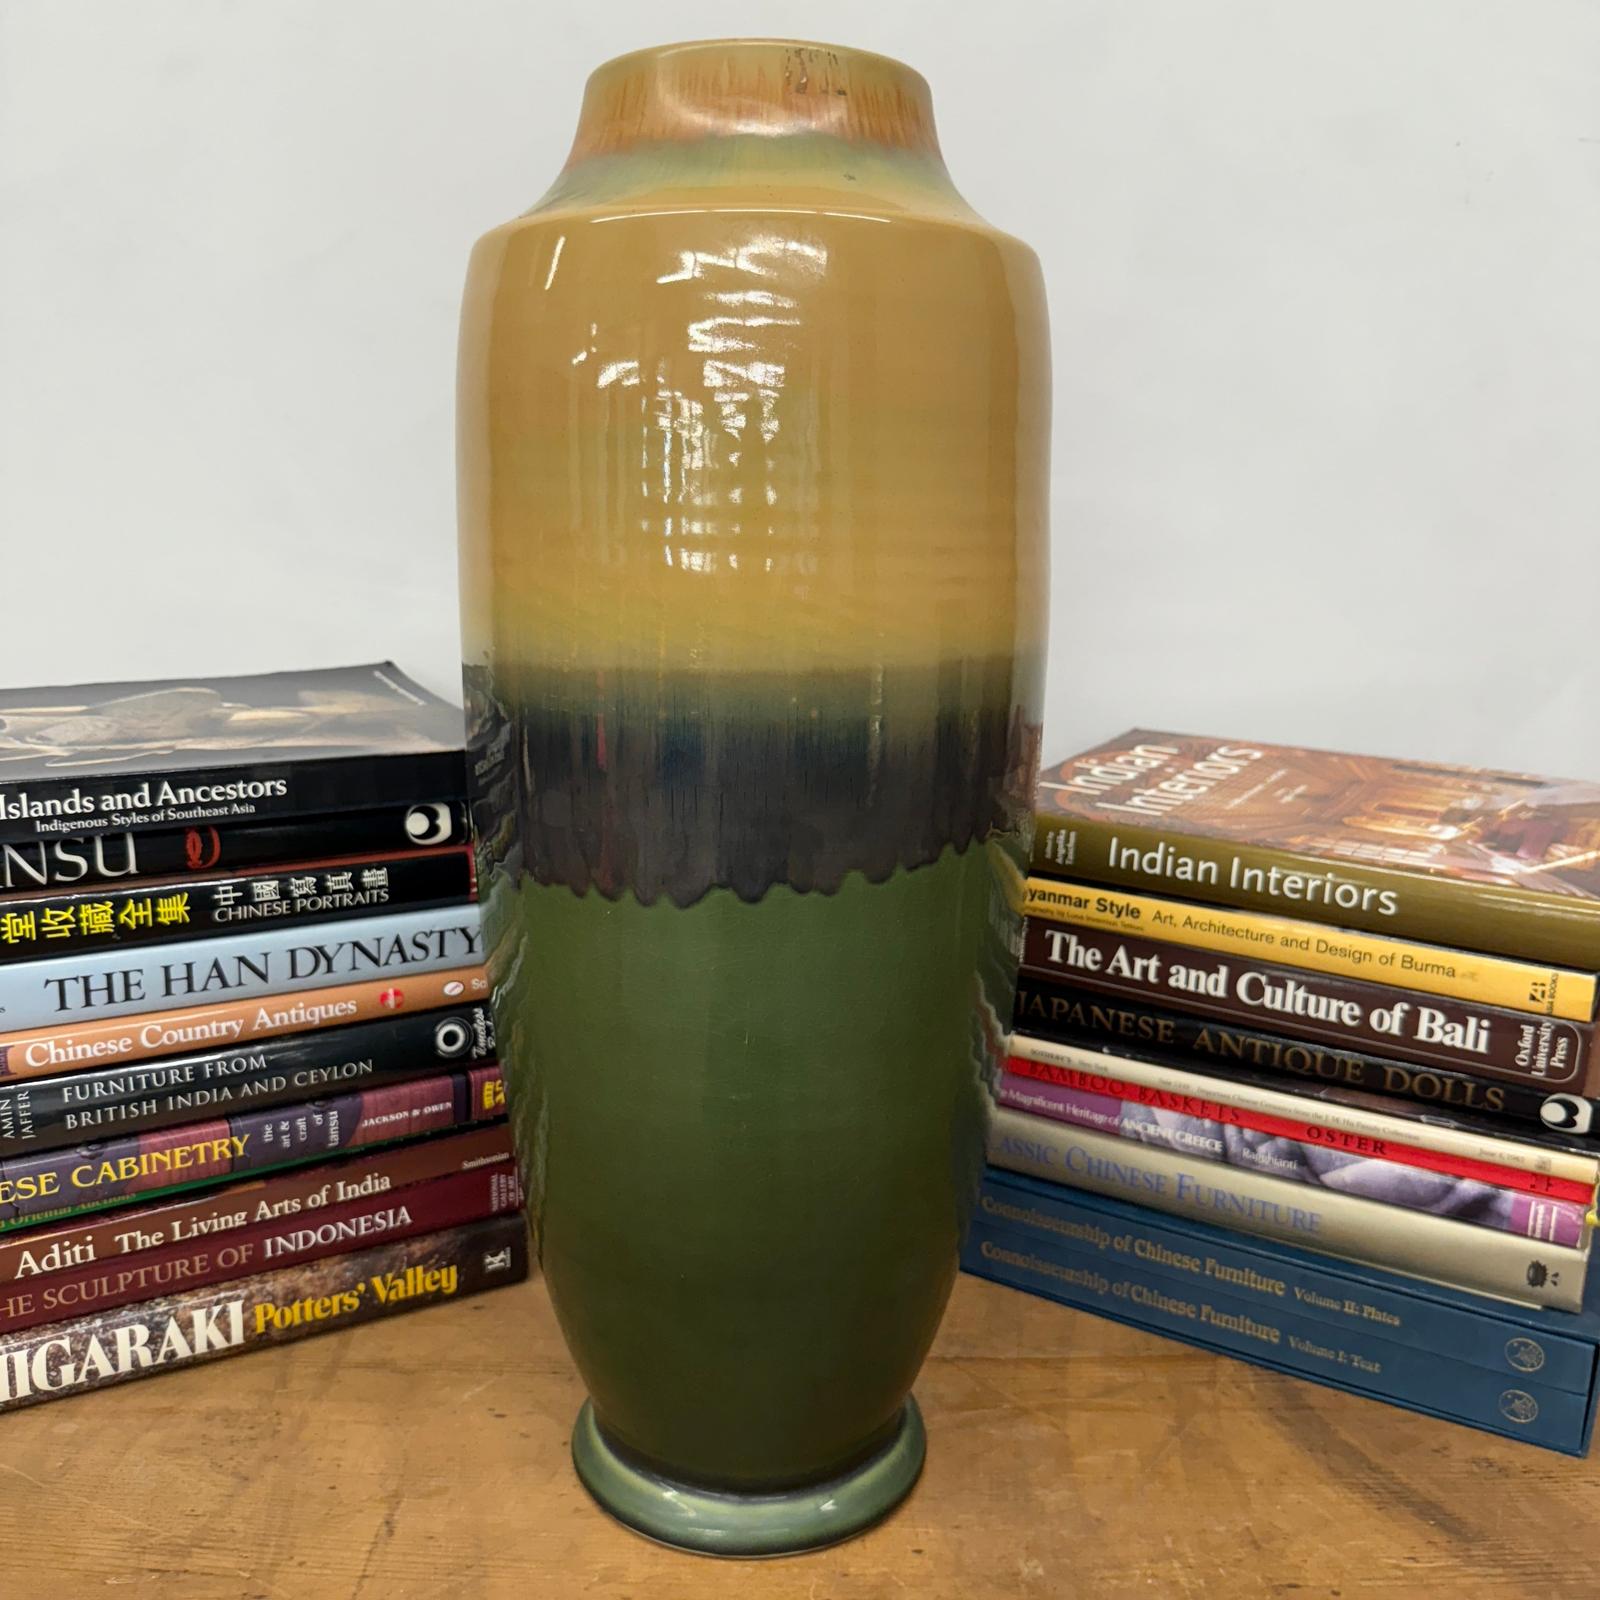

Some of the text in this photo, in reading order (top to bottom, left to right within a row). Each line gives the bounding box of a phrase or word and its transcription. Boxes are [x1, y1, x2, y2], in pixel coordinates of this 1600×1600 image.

[1038, 744, 1180, 795] Indian
[1096, 746, 1265, 817] Interiors
[0, 779, 287, 820] Islands and Ancestors
[36, 803, 255, 833] Indigenous Styles of Southeast Asia
[0, 832, 140, 888] NSU
[1108, 836, 1218, 885] Indian
[1229, 857, 1399, 915] Interiors
[214, 888, 389, 923] CHINESE PORTRAITS
[1025, 887, 1090, 909] yanmar
[1095, 898, 1141, 919] Style
[1152, 910, 1177, 929] Art,
[1183, 915, 1275, 945] Architecture
[1280, 934, 1310, 950] and
[1316, 940, 1372, 965] Design
[1378, 952, 1396, 966] of
[1401, 955, 1457, 979] Burma
[44, 926, 481, 1012] THE HAN DYNASTY
[1045, 929, 1103, 972] The
[1105, 945, 1162, 984] Art
[1168, 965, 1229, 999] and
[1236, 971, 1363, 1027] Culture
[1369, 1001, 1412, 1036] of
[1414, 1005, 1491, 1054] Bali
[25, 1000, 357, 1068] Chinese Country Antiques
[1018, 990, 1506, 1113] JAPANESE ANTIQUE DOLLS
[1515, 1024, 1535, 1067] Oxford
[1550, 1037, 1568, 1068] Press
[63, 1054, 267, 1103] FURNITURE FROM
[66, 1059, 373, 1130] BRITISH INDIA AND CEYLON
[0, 1099, 15, 1139] AMIN
[18, 1091, 37, 1139] JAFFER
[362, 1111, 409, 1127] JACKSON
[1306, 1126, 1387, 1155] OSTER
[71, 1134, 250, 1189] CABINETRY
[14, 1172, 391, 1279] Aditi The Living Arts of India
[43, 1254, 211, 1310] SCULPTURE
[217, 1243, 254, 1268] OF
[264, 1206, 413, 1259] INDONESIA
[1134, 1238, 1201, 1273] Chinese
[1205, 1257, 1286, 1297] Furniture
[254, 1282, 366, 1334] Potters'
[371, 1264, 458, 1303] Valley
[1130, 1285, 1197, 1320] Chinese
[1200, 1303, 1282, 1344] Furniture
